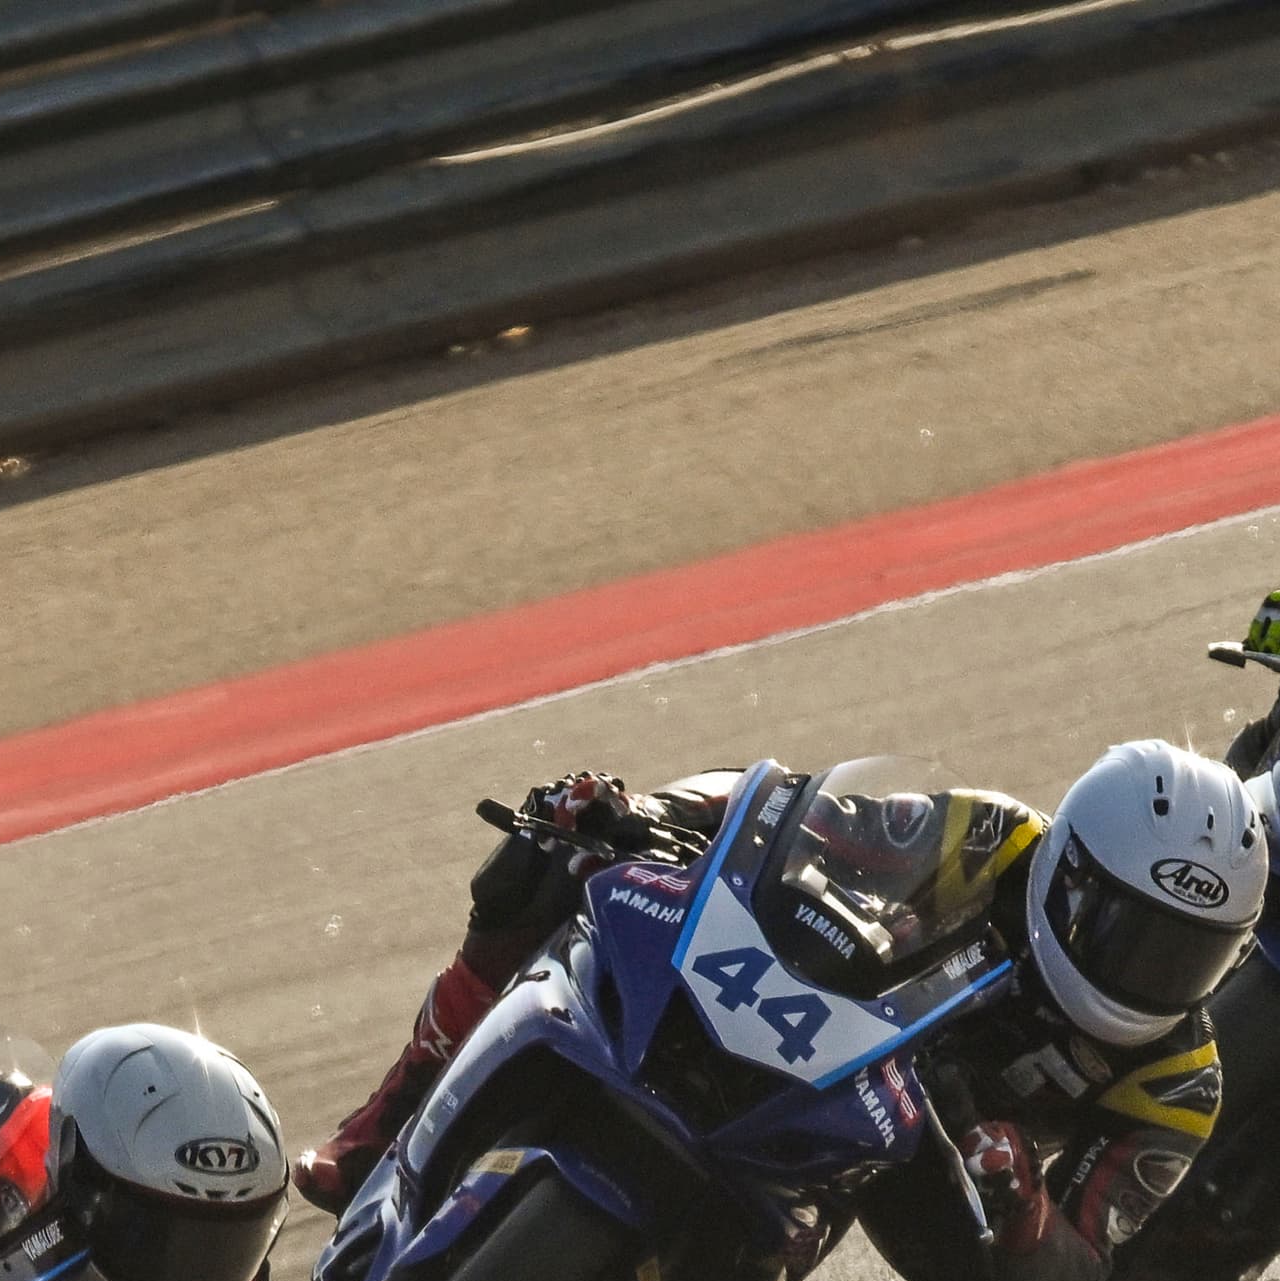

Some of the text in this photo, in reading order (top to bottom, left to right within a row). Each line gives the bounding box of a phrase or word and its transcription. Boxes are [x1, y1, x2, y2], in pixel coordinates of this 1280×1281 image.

[1158, 863, 1223, 901] Arai
[608, 887, 686, 925] YAMAHA
[793, 903, 857, 960] YAMAHA
[691, 946, 833, 1065] 44
[854, 1065, 896, 1149] YAMAHA
[187, 1145, 247, 1170] KYT
